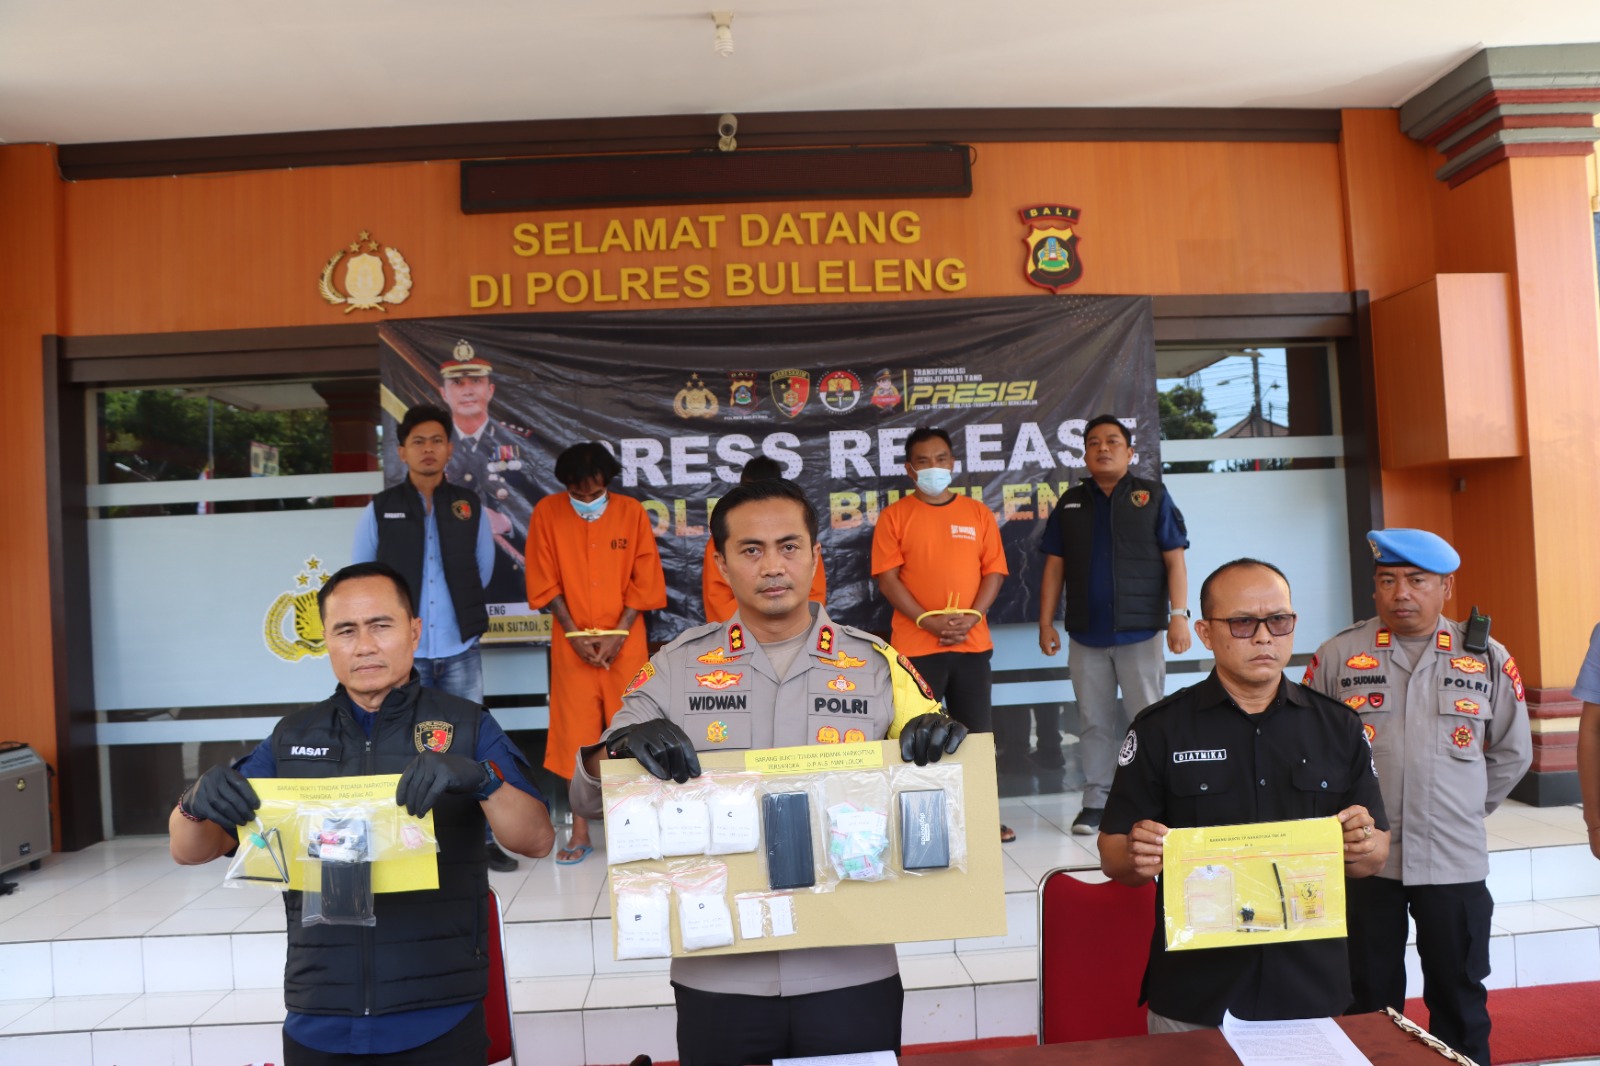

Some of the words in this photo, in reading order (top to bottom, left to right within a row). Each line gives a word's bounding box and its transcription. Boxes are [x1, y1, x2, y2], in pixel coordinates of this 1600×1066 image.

[1030, 207, 1072, 217] BALI
[512, 215, 726, 257] SELAMAT
[740, 210, 922, 248] DATANG
[470, 273, 512, 308] DI
[527, 264, 711, 306] POLRES
[726, 258, 967, 297] BULELENG
[913, 368, 966, 376] TRANSFORMASI
[913, 375, 942, 384] MENUJU
[943, 375, 964, 383] POLRI
[964, 374, 983, 382] YANG
[908, 380, 1038, 407] PRESISI
[579, 432, 803, 487] RESS
[829, 418, 1139, 478] REEAS
[1353, 675, 1387, 685] SUDIANA
[1444, 677, 1488, 694] POLRI
[689, 694, 747, 711] WIDWAN
[814, 697, 868, 715] POLRI
[290, 745, 329, 756] KASAT
[1179, 751, 1223, 761] DIATMIKA
[364, 781, 398, 789] NARKOTIKA
[624, 818, 631, 826] A
